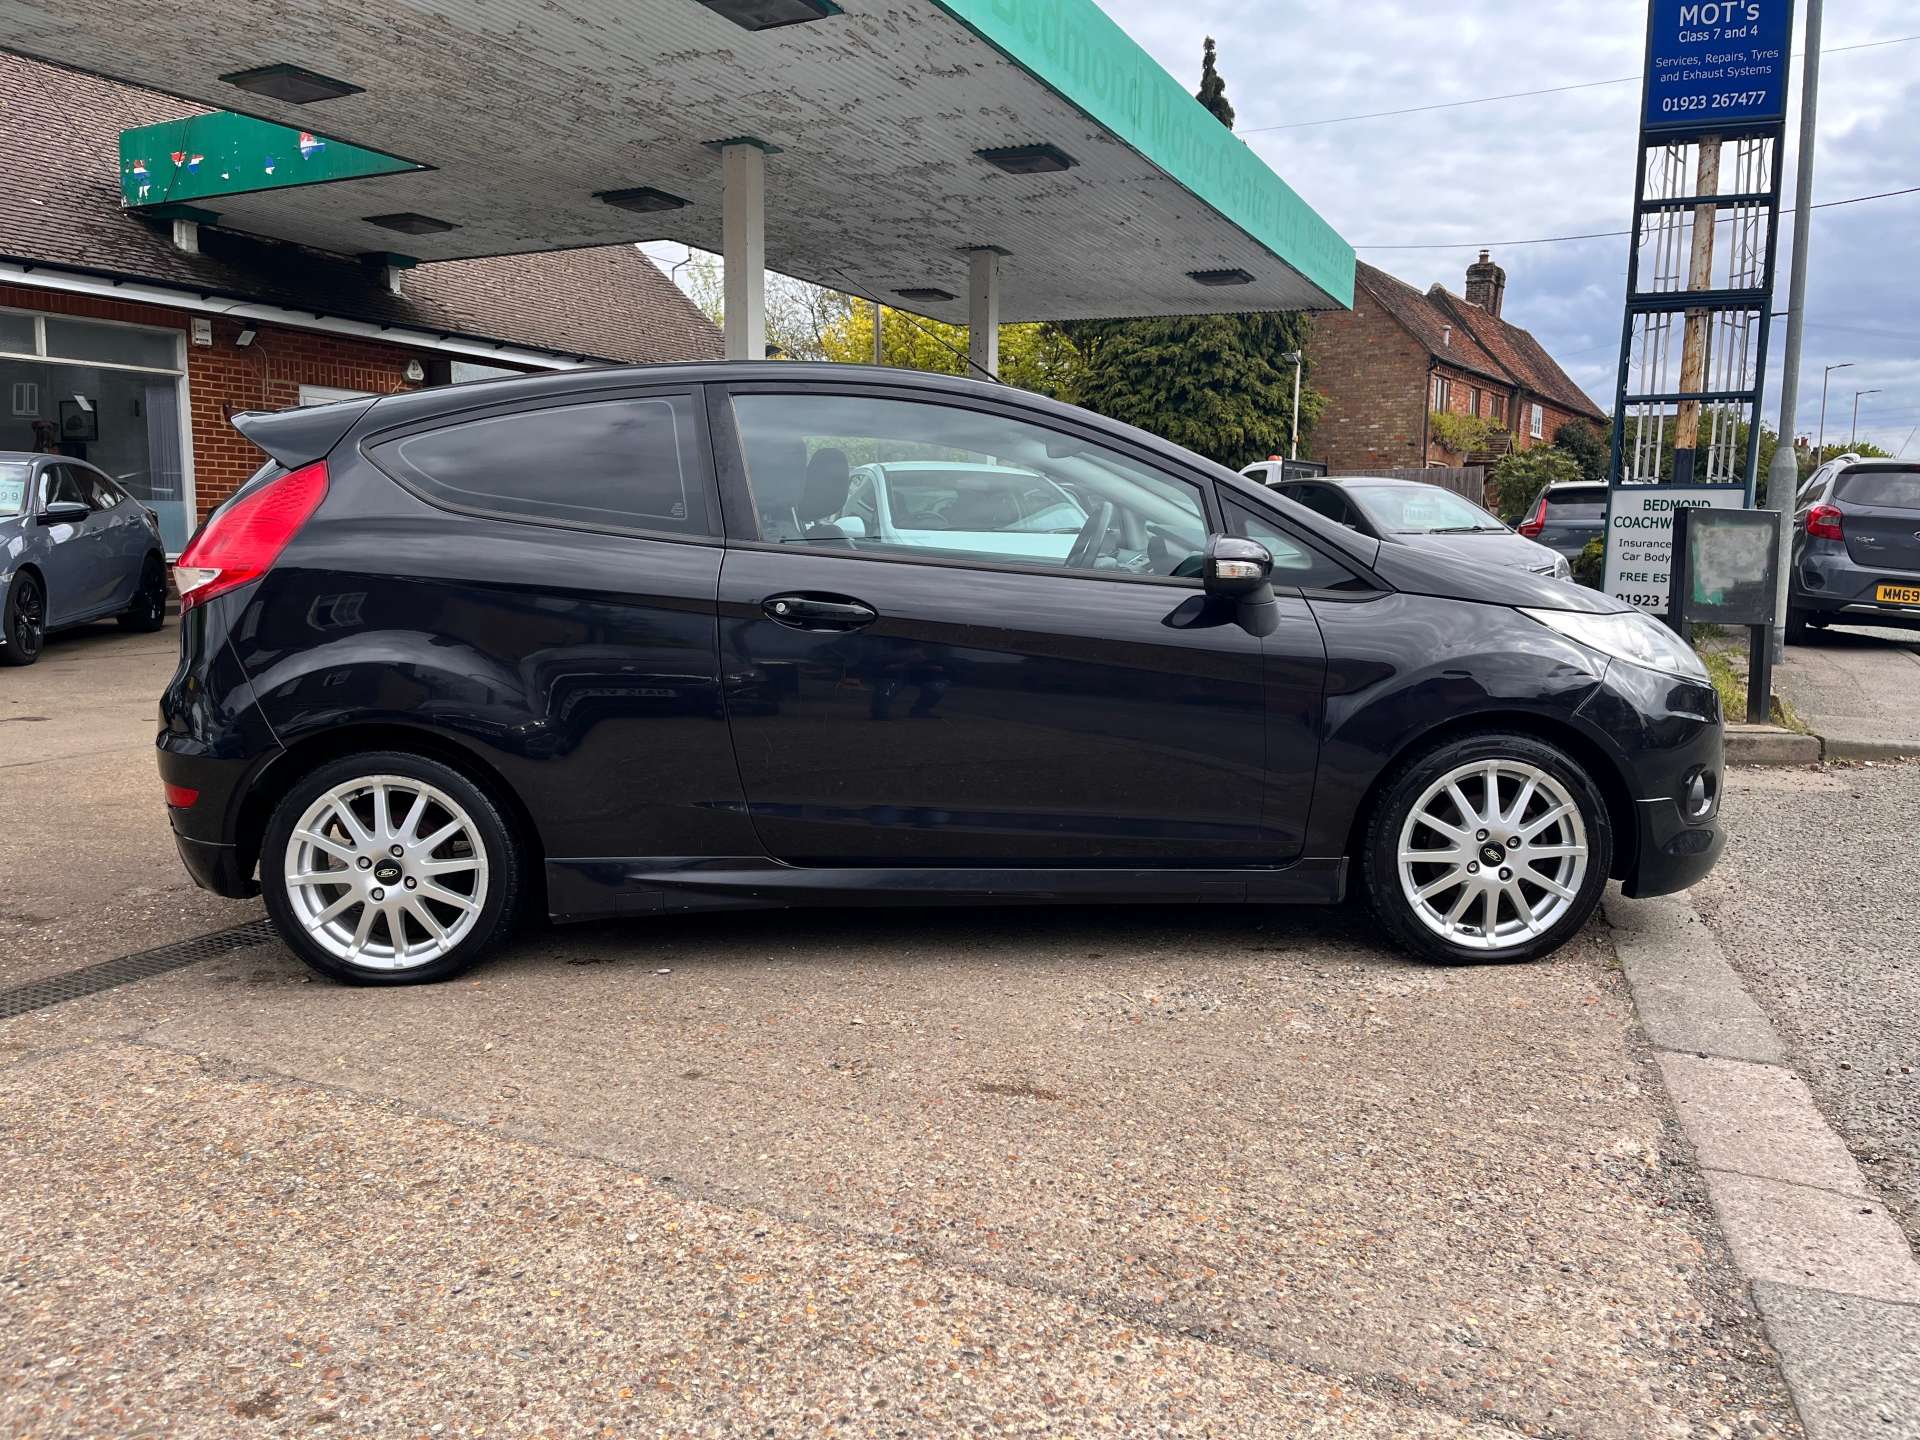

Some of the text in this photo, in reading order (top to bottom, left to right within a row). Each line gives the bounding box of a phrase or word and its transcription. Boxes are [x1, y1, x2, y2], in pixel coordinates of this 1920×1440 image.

[1679, 1, 1760, 27] MOT's
[1678, 25, 1758, 43] Class 7 and 4
[991, 0, 1142, 129] edmond
[1655, 49, 1779, 68] Services, Repairs, Tyres
[1660, 65, 1772, 83] and Exhaust Systems
[1662, 90, 1766, 112] 01923 267477
[1643, 499, 1711, 511] BEDMOND
[1614, 516, 1673, 529] COACHW
[1618, 538, 1672, 549] Insurance
[1622, 552, 1671, 564] Car Body
[1619, 572, 1670, 583] FREE ES
[1883, 588, 1919, 602] MM69
